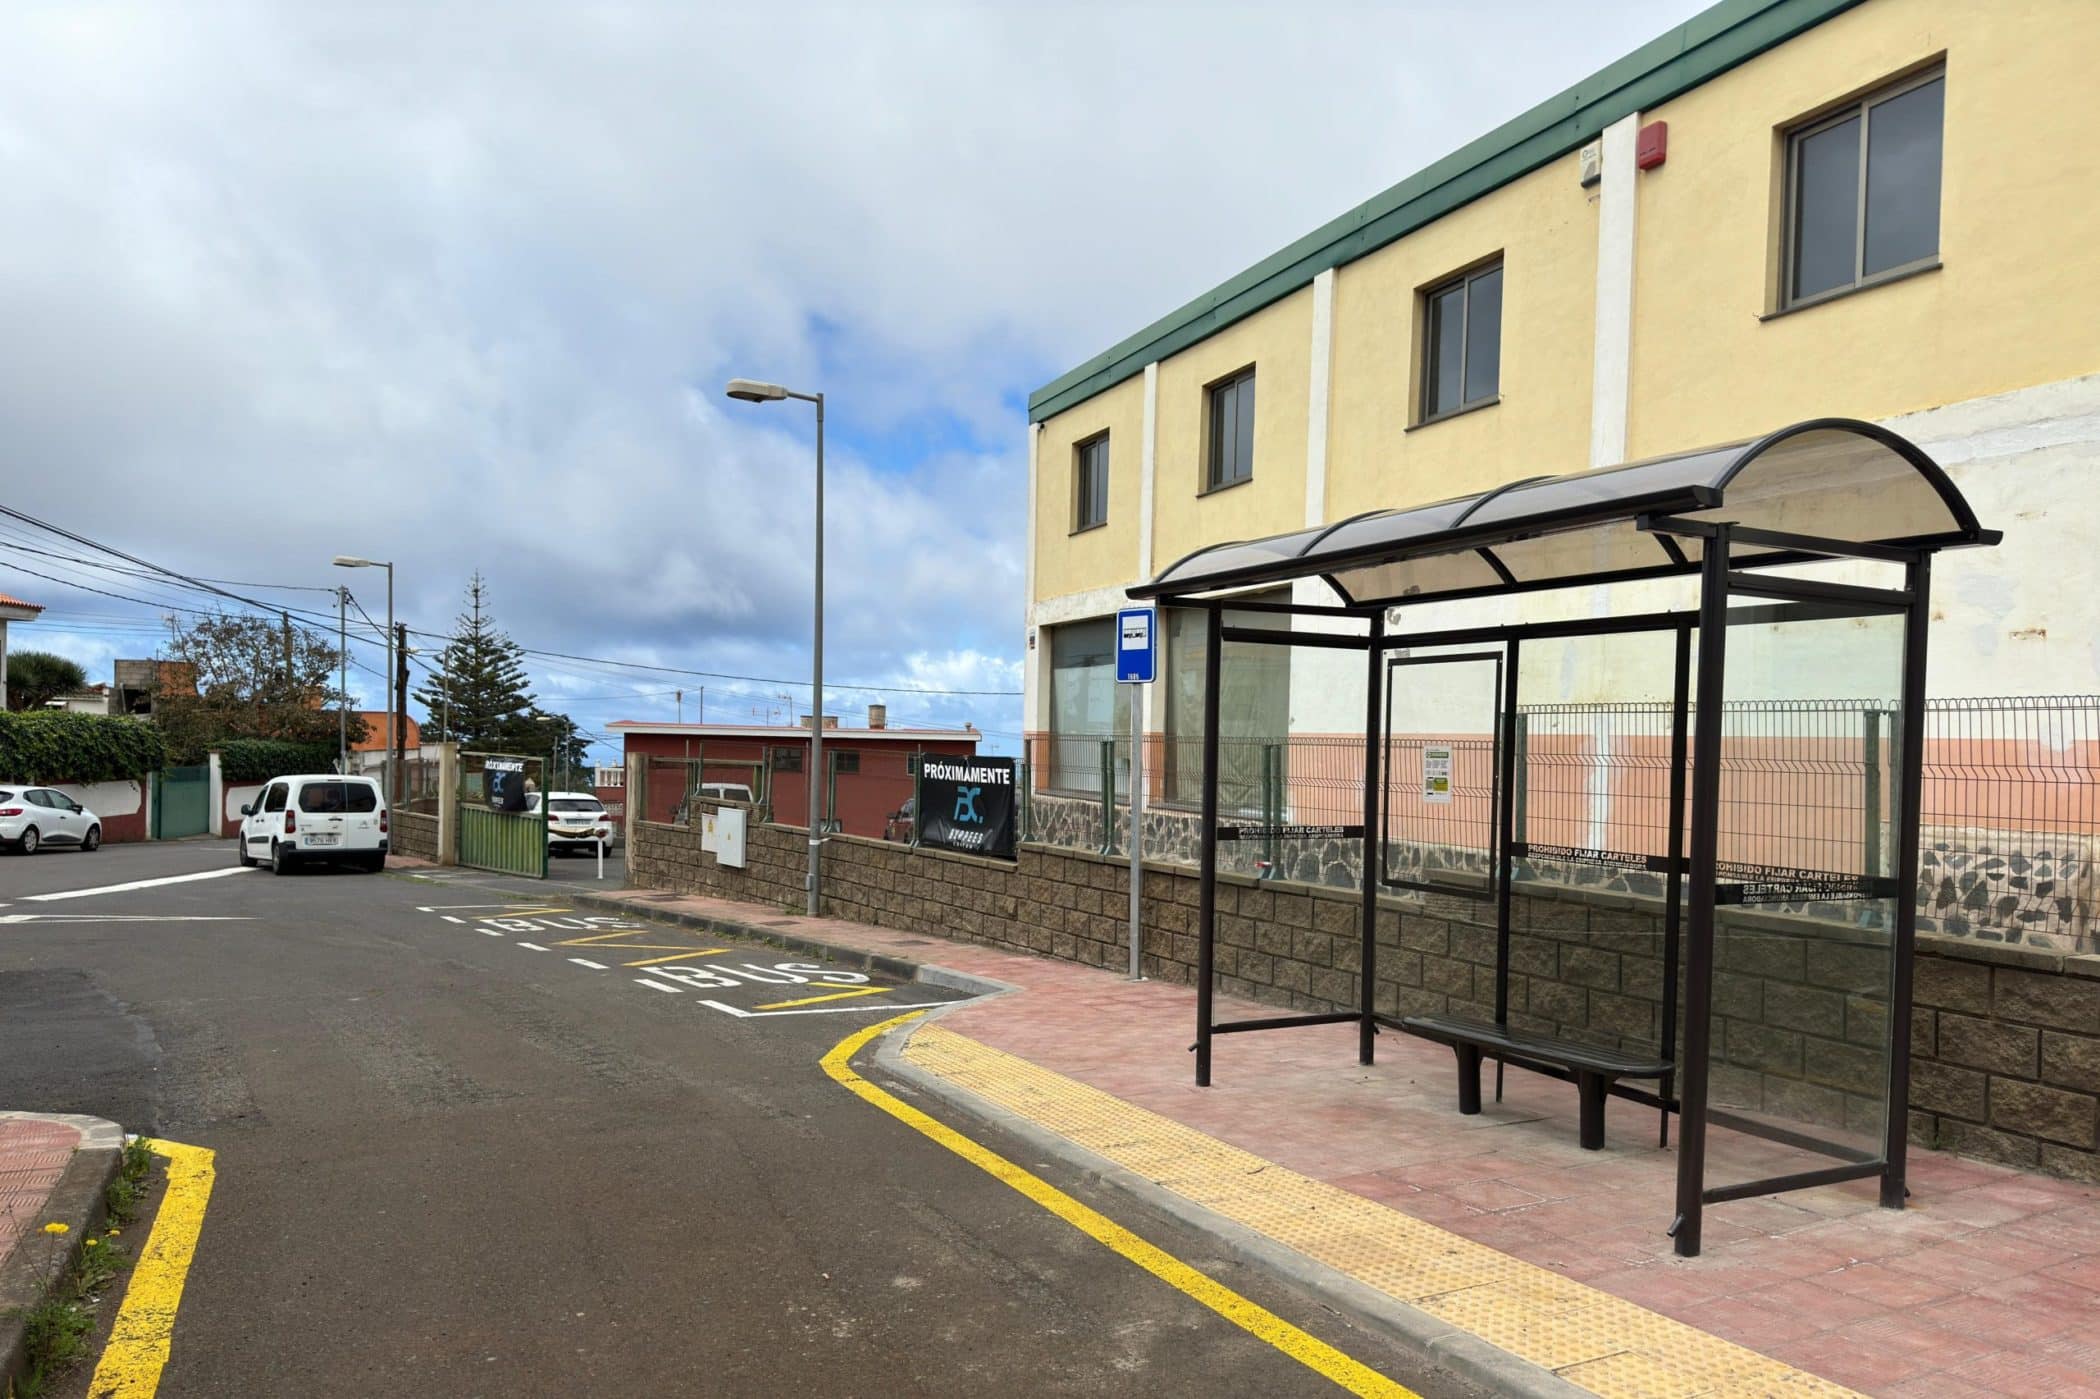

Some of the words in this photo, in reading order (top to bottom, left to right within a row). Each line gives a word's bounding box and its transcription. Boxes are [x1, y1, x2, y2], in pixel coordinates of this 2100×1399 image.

[924, 761, 1010, 784] PRÓXIMAMENTE
[1528, 844, 1573, 856] PROHIBIDO
[1601, 851, 1648, 864] CARTELES
[1716, 861, 1762, 875] OHIBIDO
[1765, 867, 1796, 878] FIJAR
[479, 916, 643, 932] BUS
[640, 962, 870, 989] BUS
